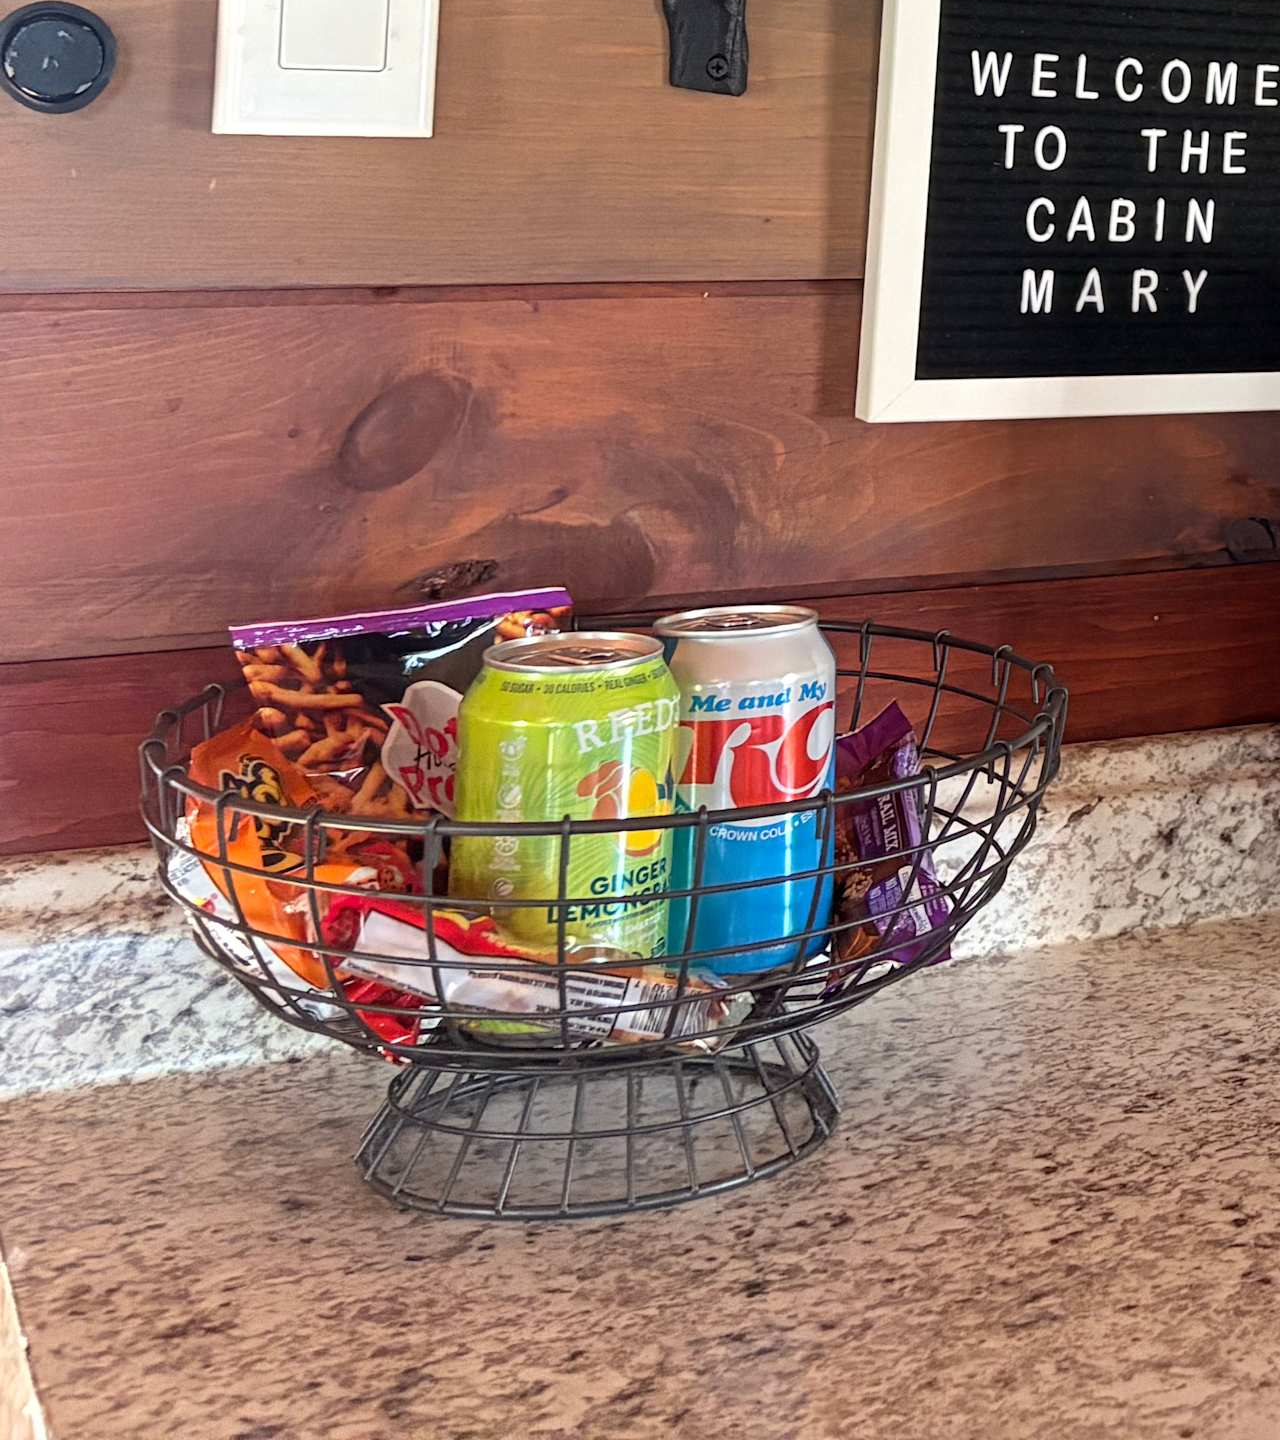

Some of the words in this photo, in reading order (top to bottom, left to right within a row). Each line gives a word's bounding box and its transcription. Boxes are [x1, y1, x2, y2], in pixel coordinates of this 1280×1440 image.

[971, 50, 1280, 106] WELCOME
[998, 124, 1067, 171] TO
[1140, 128, 1248, 174] THE
[1025, 196, 1216, 244] CABIN
[1019, 267, 1208, 314] MARY
[555, 680, 597, 695] CALORIES
[688, 694, 732, 712] Me
[737, 687, 792, 710] and
[797, 679, 827, 702] My
[678, 701, 835, 809] RC
[877, 793, 895, 828] RAIL
[709, 825, 758, 841] CROWN
[884, 824, 899, 852] MIX
[590, 857, 667, 895] GINGER
